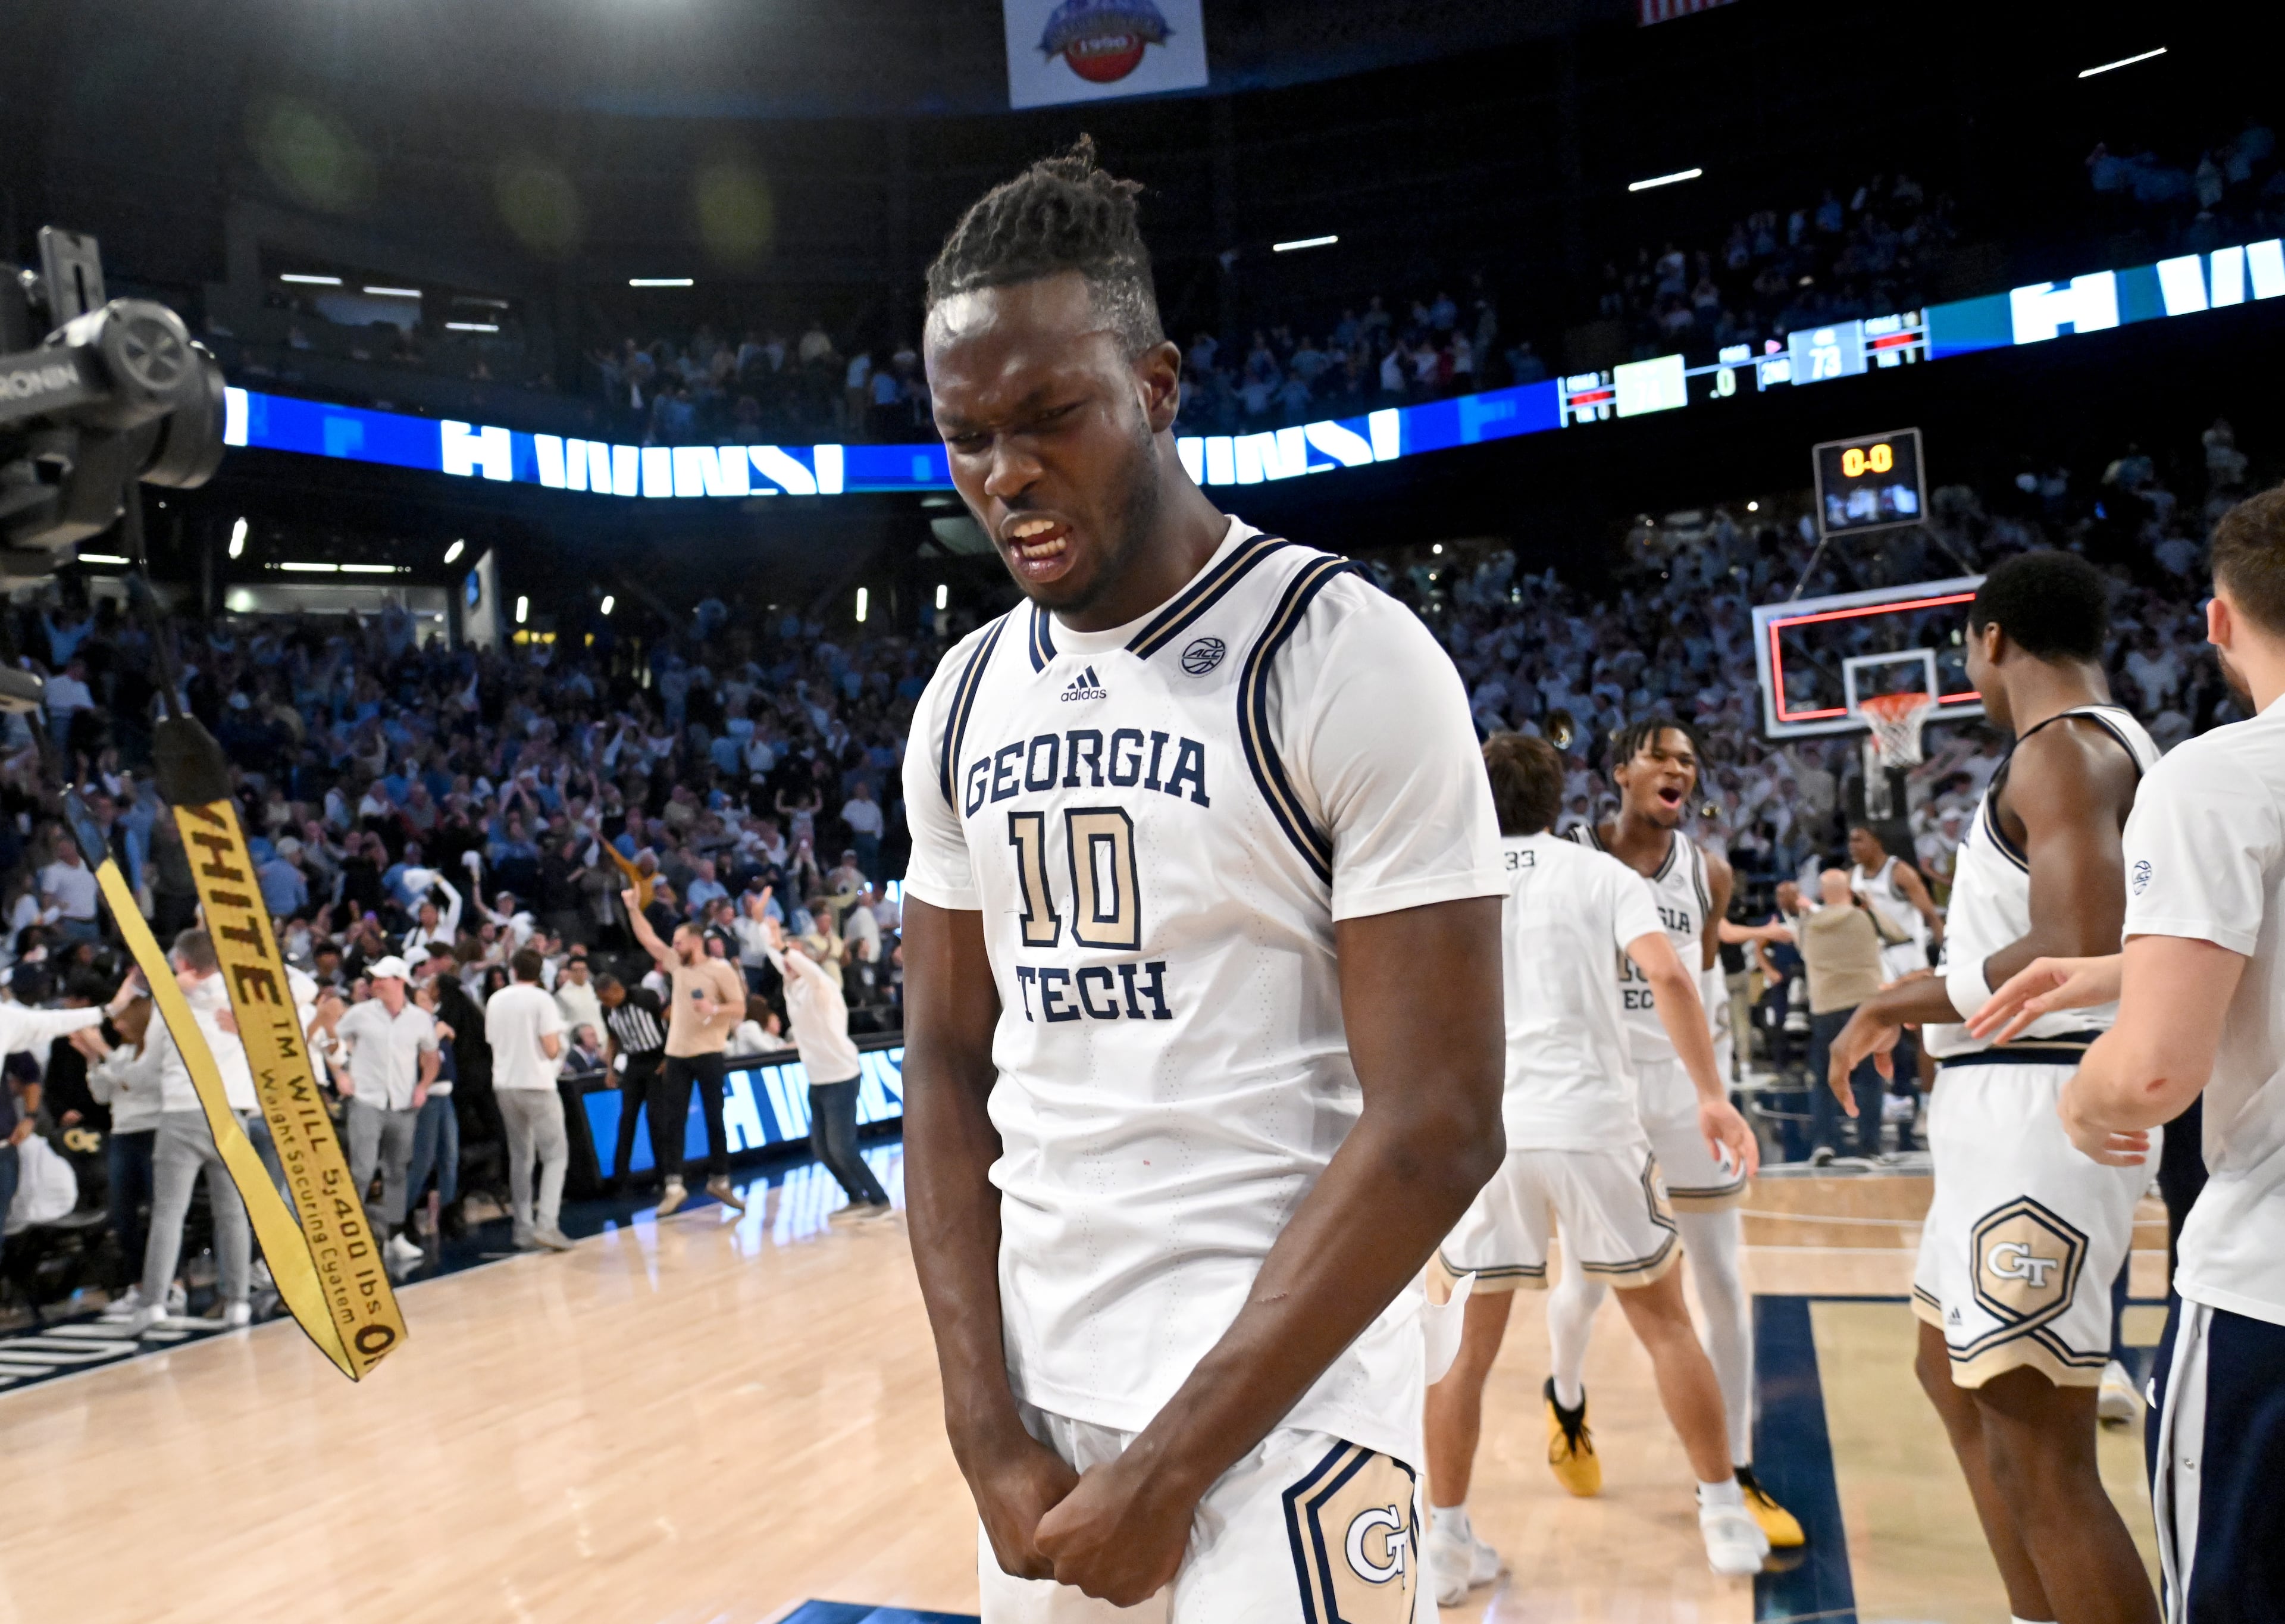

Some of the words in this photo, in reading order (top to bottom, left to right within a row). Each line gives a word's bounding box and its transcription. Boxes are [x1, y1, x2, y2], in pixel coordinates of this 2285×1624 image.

[1808, 345, 1842, 380] 73
[1187, 649, 1224, 658] ACC
[1061, 687, 1107, 702] adidas
[966, 728, 1210, 819] GEORGIA
[1007, 806, 1141, 951] 10
[1504, 850, 1535, 871] 33
[1016, 962, 1172, 1023] TECH
[287, 1075, 328, 1153] WILL
[355, 1269, 382, 1315] lbs
[1987, 1241, 2058, 1288] GT
